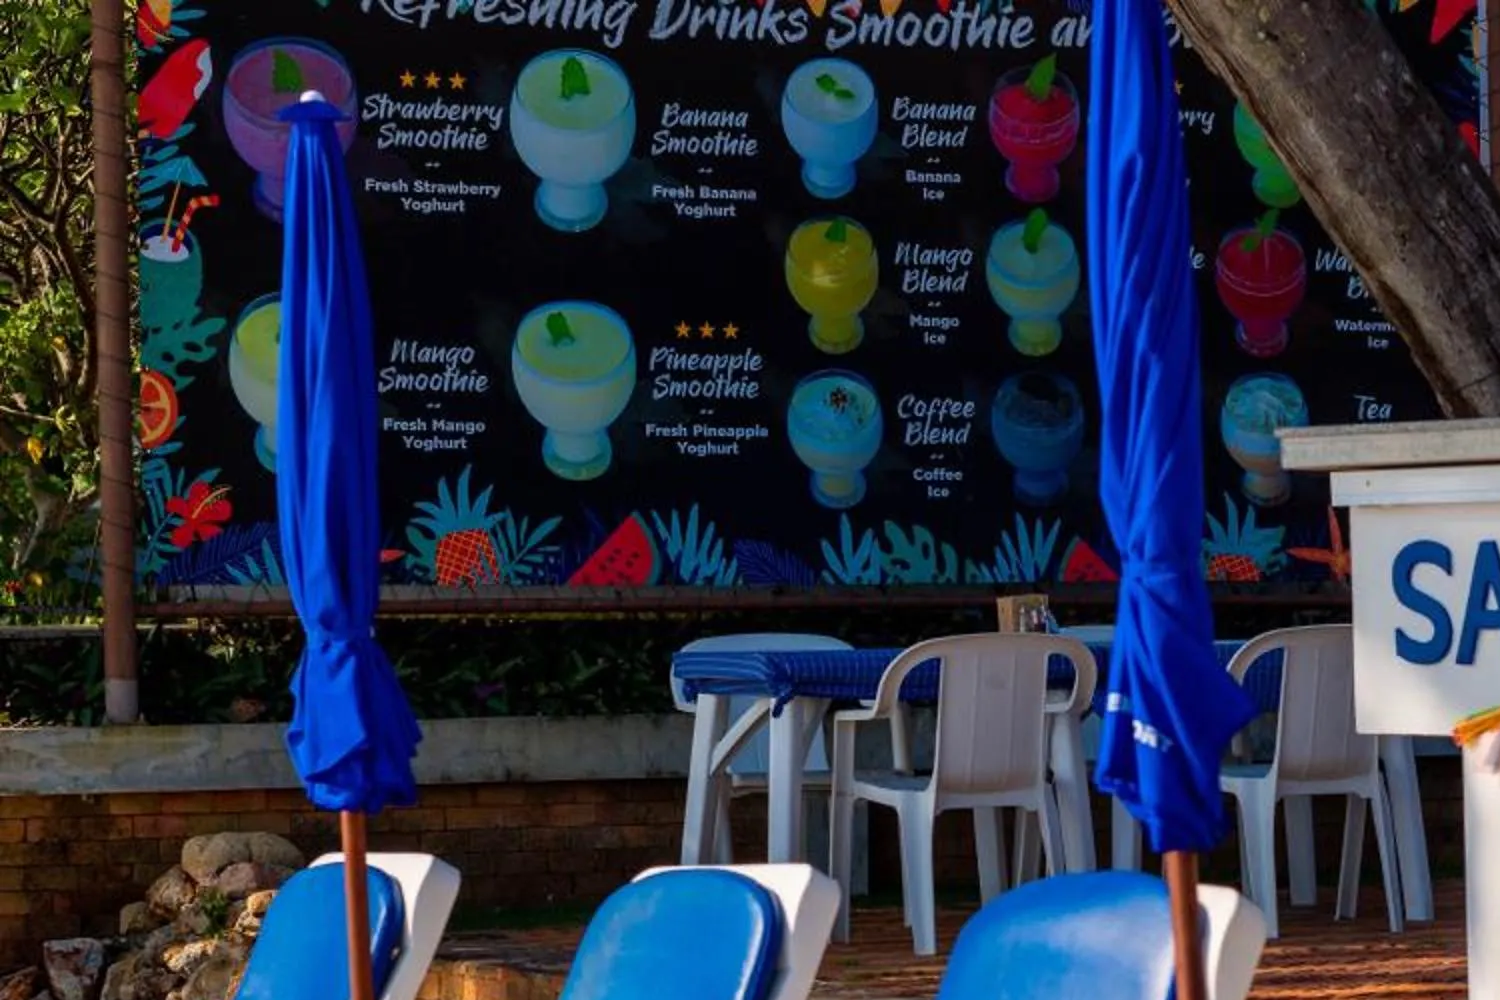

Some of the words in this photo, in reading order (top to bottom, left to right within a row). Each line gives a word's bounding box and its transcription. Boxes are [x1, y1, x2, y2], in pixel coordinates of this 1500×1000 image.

[649, 0, 808, 45] Drinks
[826, 2, 1034, 51] Smoothie
[361, 93, 504, 130] Strawberry
[661, 102, 749, 128] Banana
[892, 96, 977, 121] Banana
[377, 122, 489, 150] Smoothie
[651, 129, 759, 157] Smoothie
[902, 122, 968, 149] Blend
[364, 177, 409, 194] Fresh
[413, 179, 501, 199] Strawberry
[905, 169, 962, 183] Banana
[651, 183, 695, 199] Fresh
[699, 185, 757, 200] Banana
[922, 187, 945, 200] Ice
[400, 196, 465, 214] Yoghurt
[674, 202, 737, 219] Yoghurt
[895, 241, 974, 273] Mango
[902, 268, 969, 294] Blend
[909, 313, 960, 330] Mango
[923, 330, 947, 345] Ice
[1367, 336, 1390, 349] Ice
[390, 338, 476, 370] Mango
[649, 346, 764, 382] Pineapple
[377, 366, 490, 393] Smoothie
[652, 372, 760, 400] Smoothie
[897, 393, 975, 423] Coffee
[1353, 394, 1393, 421] Tea
[383, 417, 427, 431] Fresh
[431, 419, 486, 435] Mango
[645, 423, 688, 438] Fresh
[692, 423, 769, 441] Pineapple
[904, 420, 972, 447] Blend
[402, 435, 468, 452] Yoghurt
[677, 440, 740, 457] Yoghurt
[912, 467, 964, 481] Coffee
[926, 484, 950, 499] Ice
